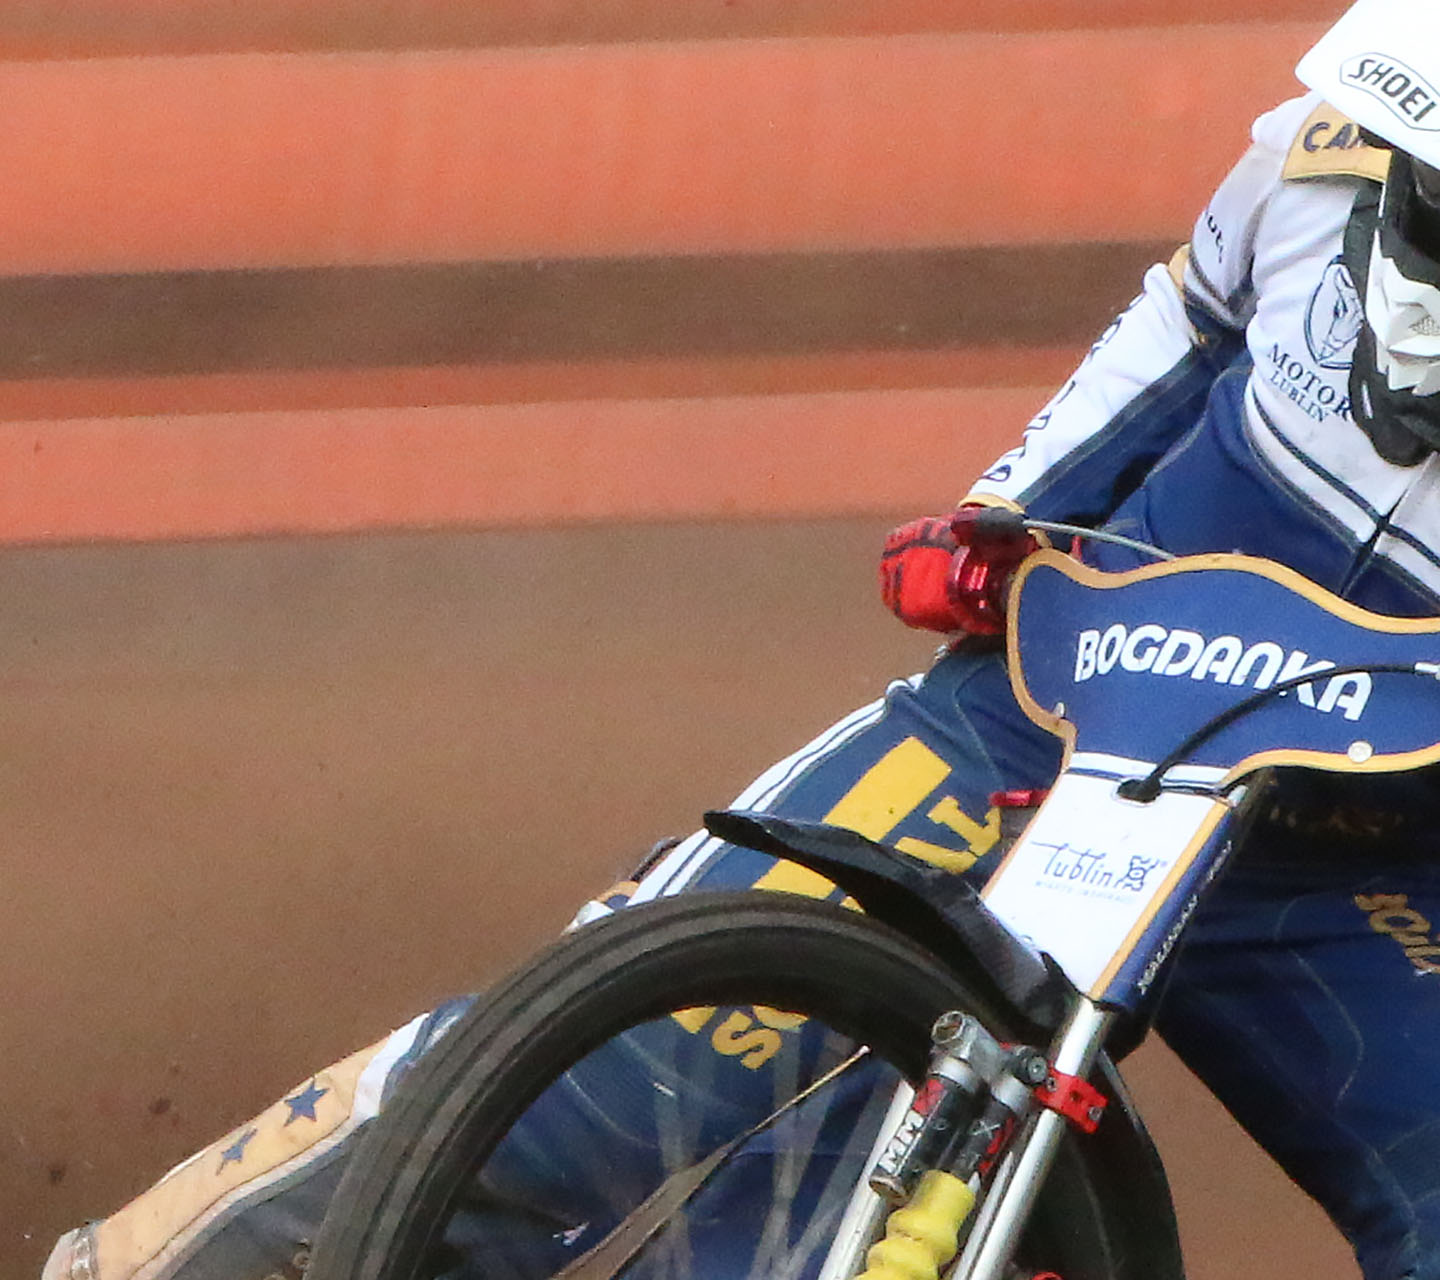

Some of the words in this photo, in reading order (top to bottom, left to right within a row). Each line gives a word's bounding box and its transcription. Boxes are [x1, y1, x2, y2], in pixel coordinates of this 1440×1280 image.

[1347, 58, 1437, 122] SHOEI
[1267, 342, 1354, 422] MOTOR
[1073, 623, 1373, 722] BOGDANKA
